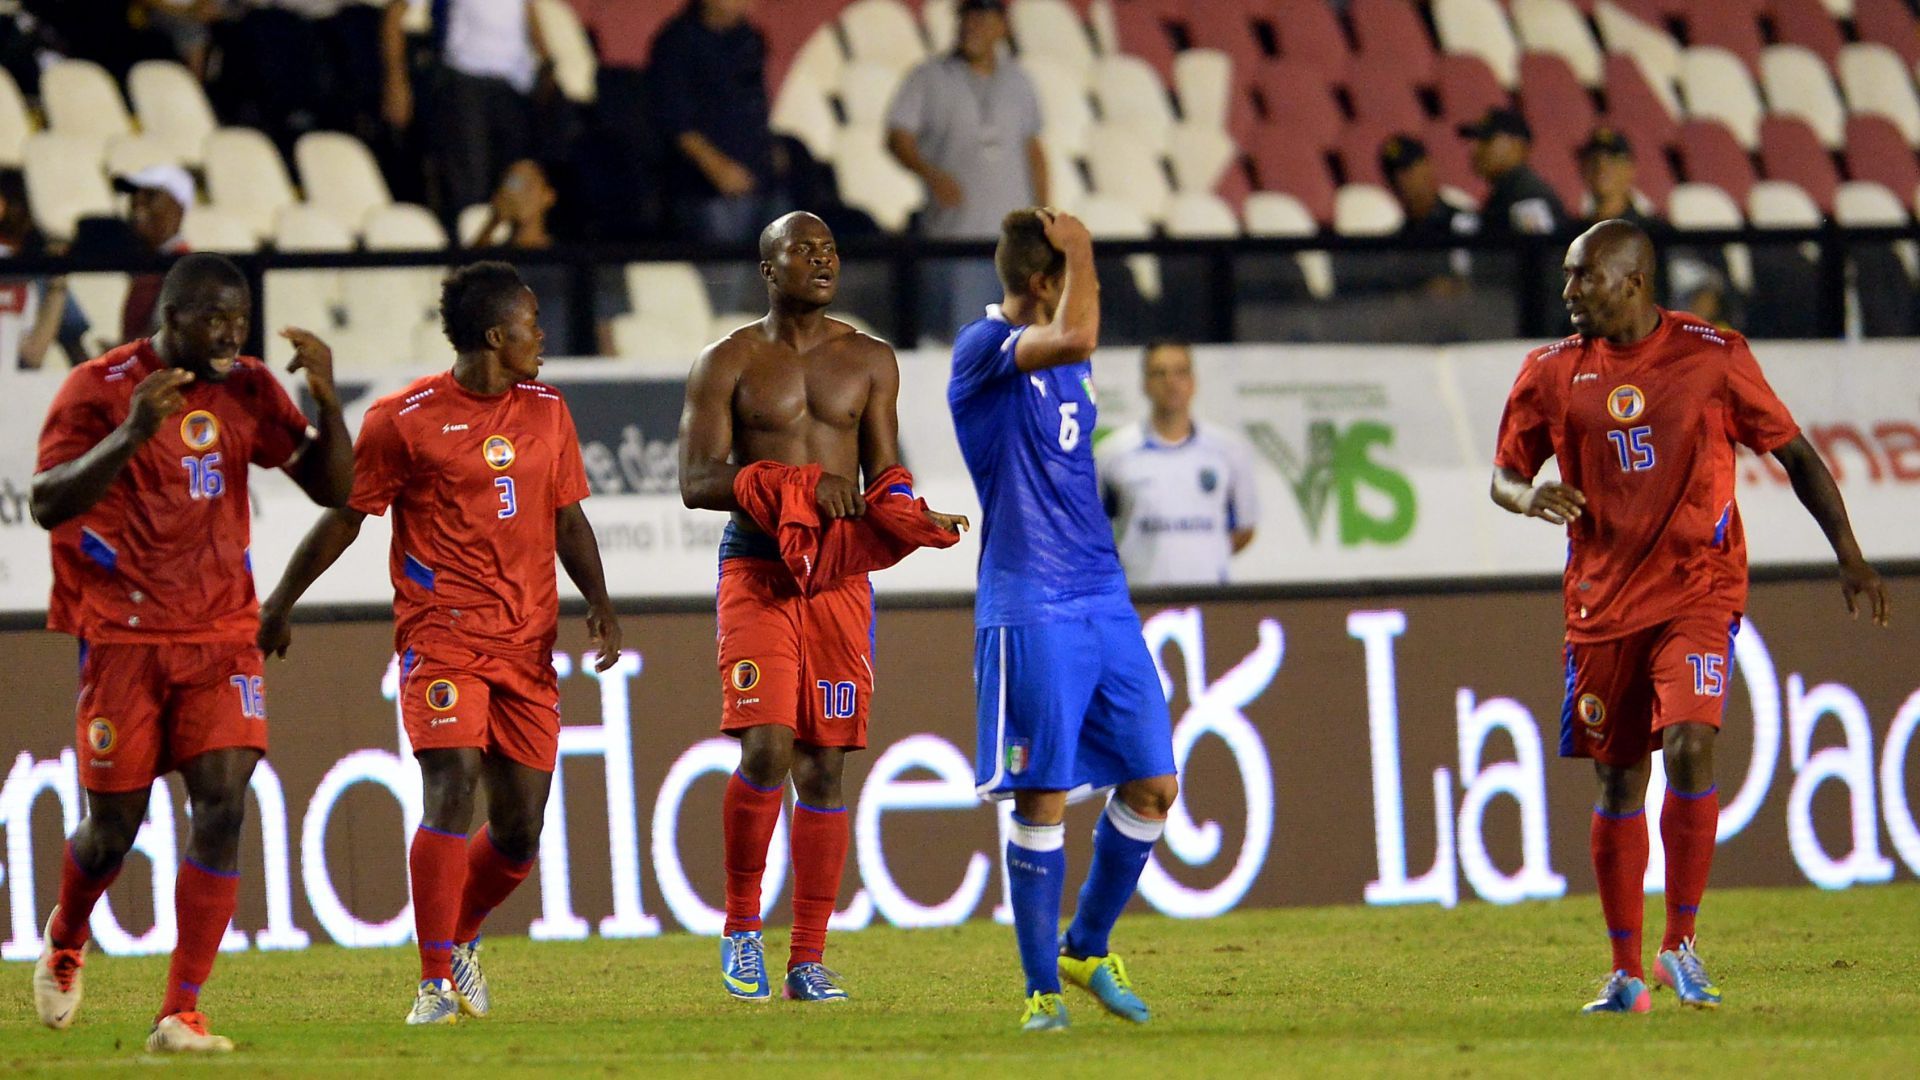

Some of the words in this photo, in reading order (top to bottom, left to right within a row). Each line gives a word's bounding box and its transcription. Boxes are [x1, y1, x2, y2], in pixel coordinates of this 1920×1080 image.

[1057, 402, 1080, 452] 6
[1606, 426, 1656, 473] 15
[180, 452, 225, 500] 16
[494, 475, 517, 519] 3
[1686, 652, 1725, 698] 15
[817, 680, 856, 719] 10
[1346, 609, 1567, 909] La
